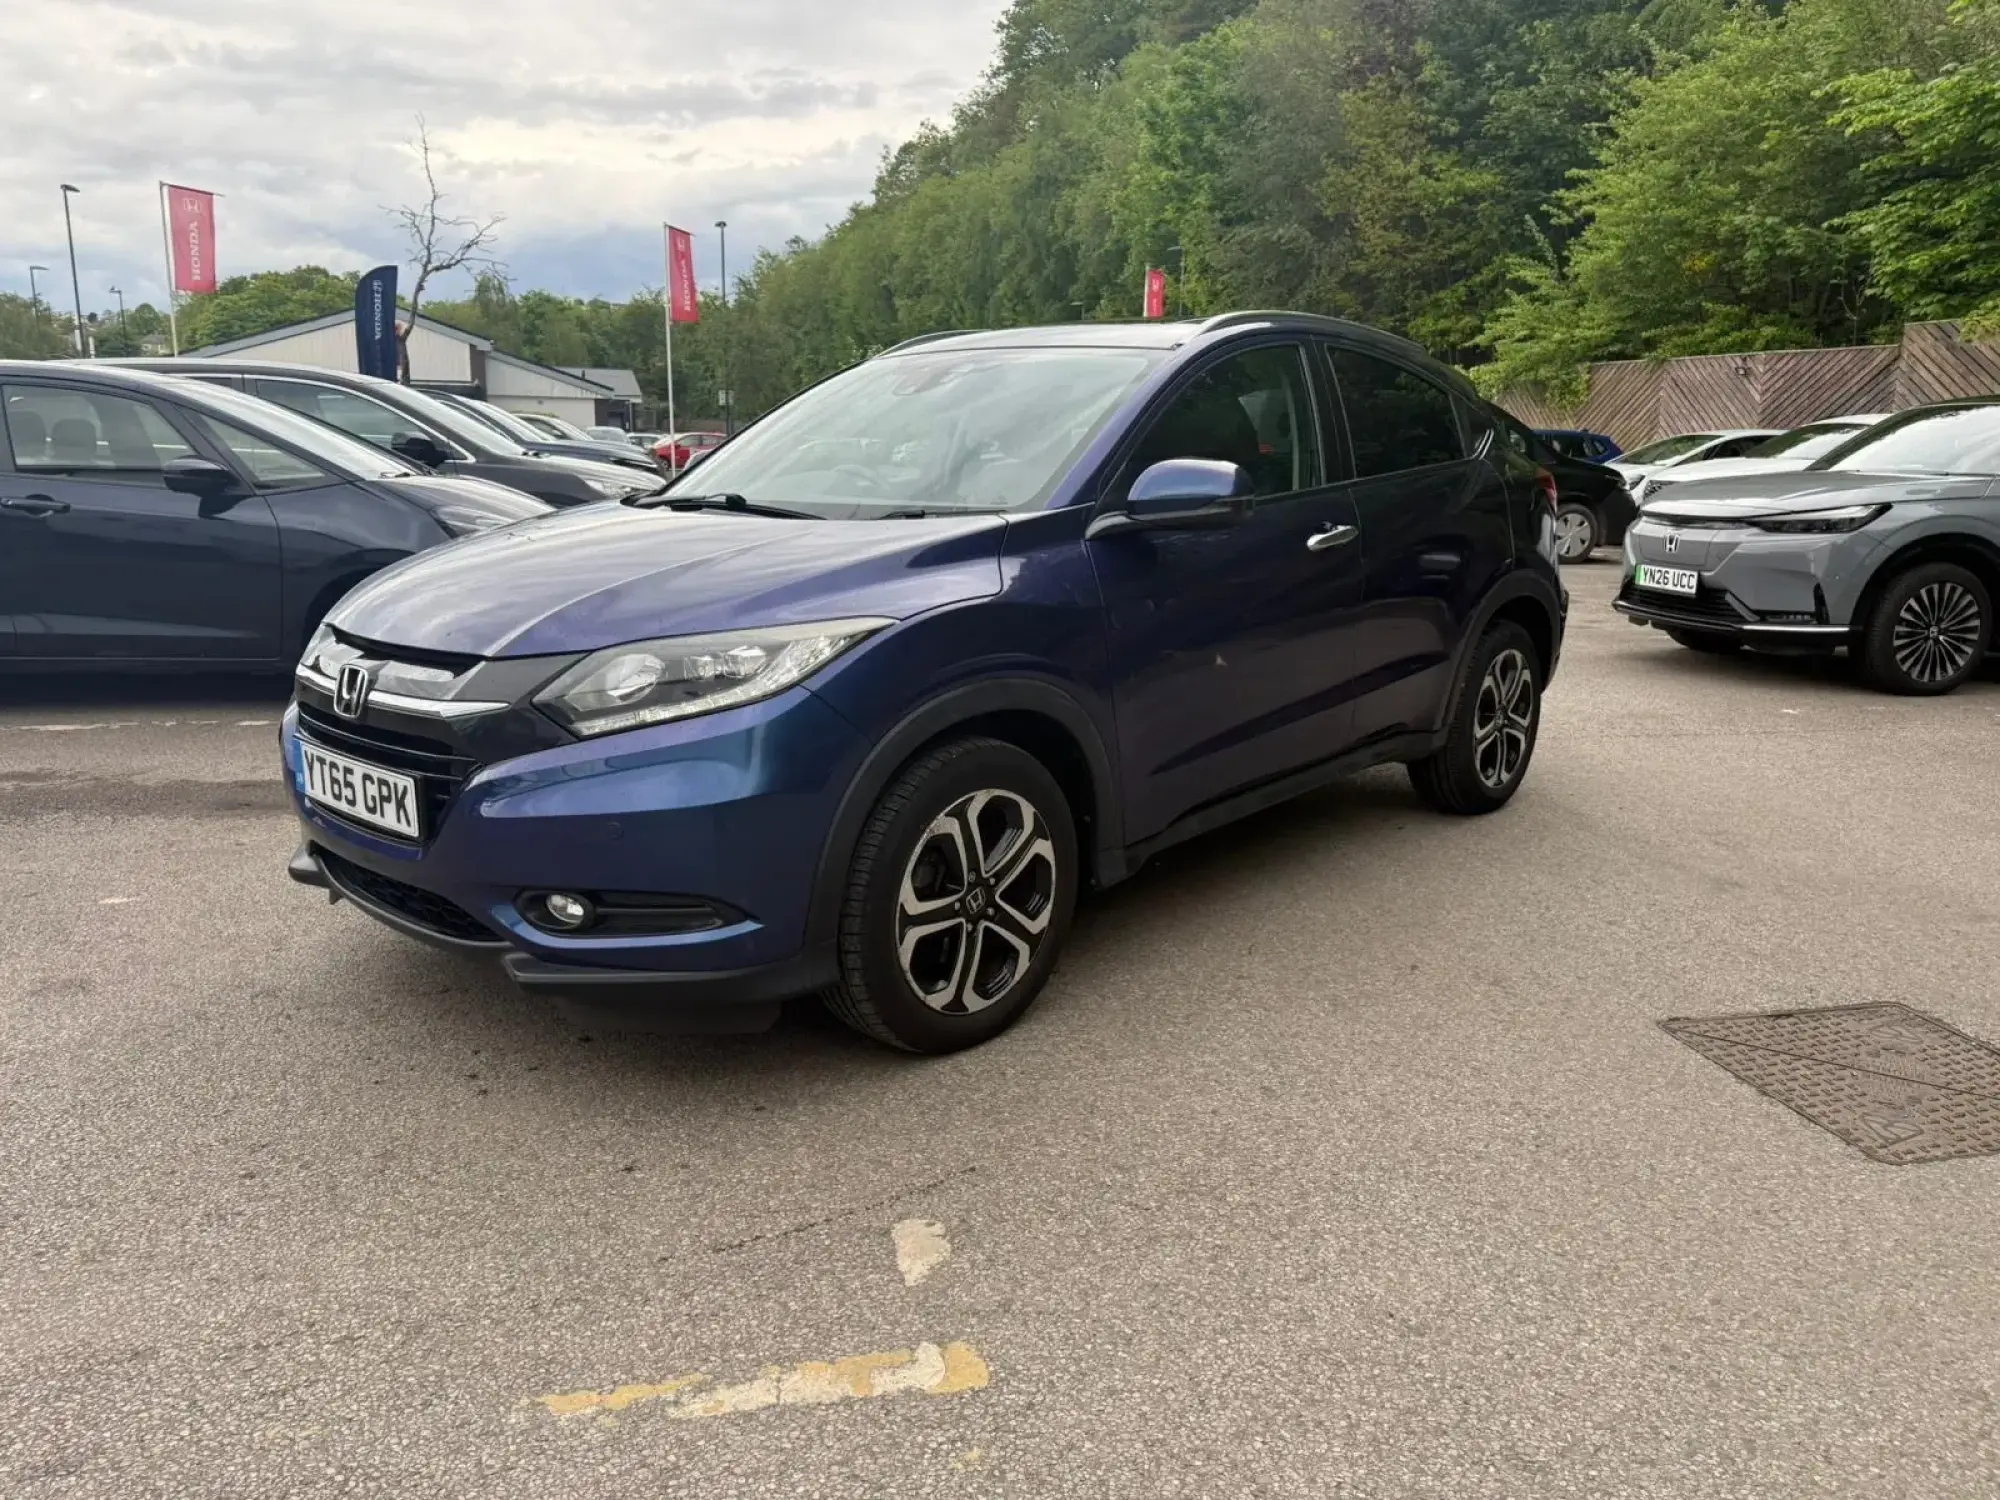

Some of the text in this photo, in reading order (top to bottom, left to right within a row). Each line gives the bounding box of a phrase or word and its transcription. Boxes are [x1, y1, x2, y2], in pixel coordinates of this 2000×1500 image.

[189, 219, 200, 281] HONDA
[374, 291, 383, 341] HONDA
[1643, 567, 1695, 590] YN26 UCC
[304, 749, 411, 828] YT65 GPK
